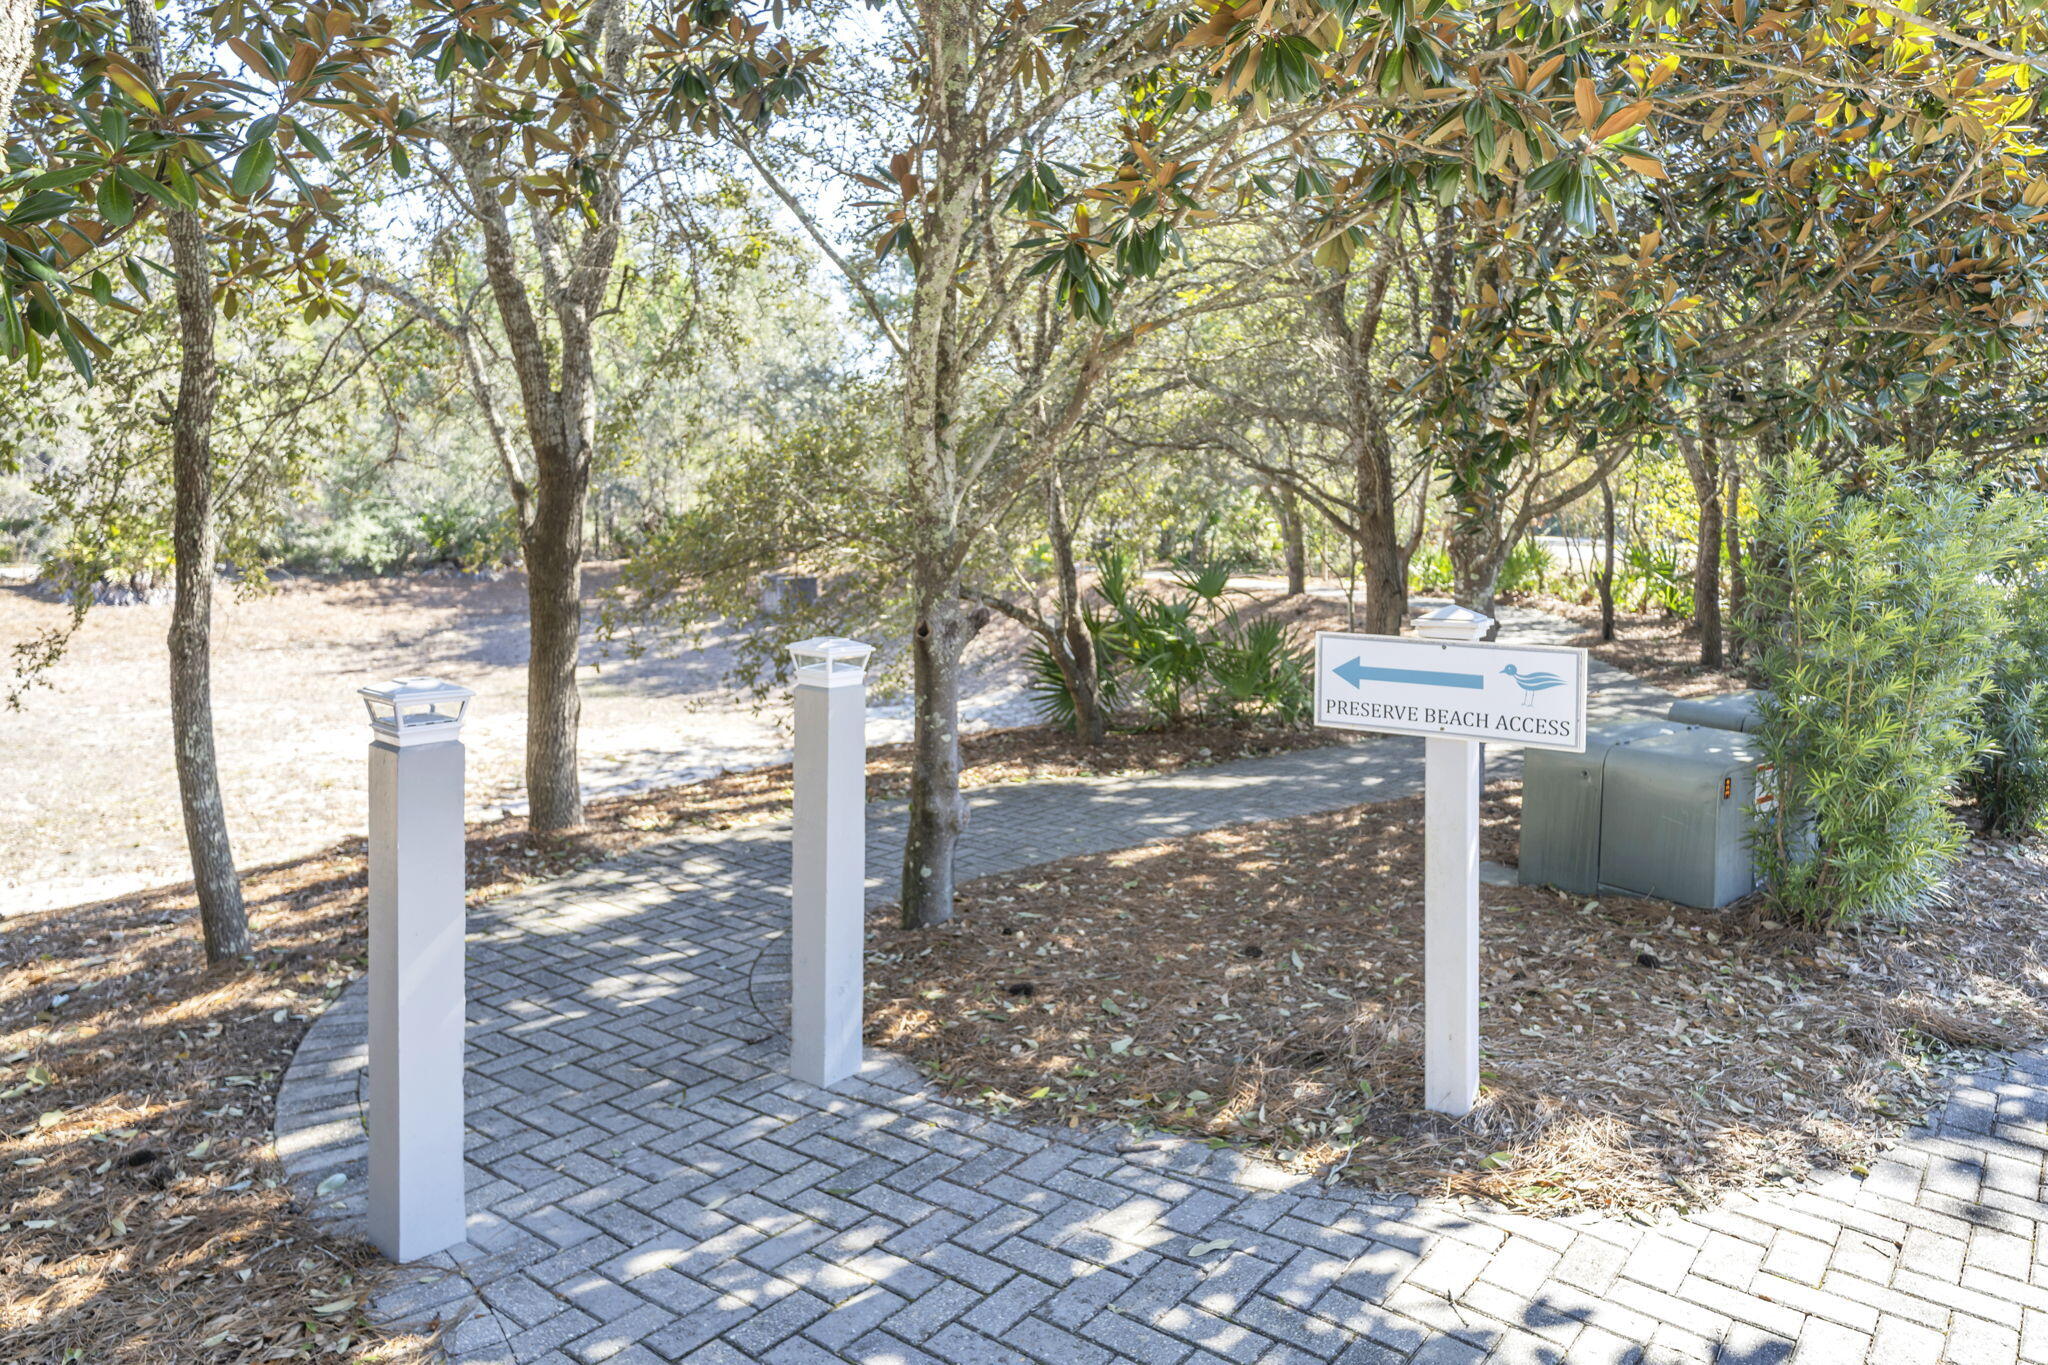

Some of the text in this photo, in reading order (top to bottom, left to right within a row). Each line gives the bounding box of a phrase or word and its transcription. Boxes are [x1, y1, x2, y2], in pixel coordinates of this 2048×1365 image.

[1326, 699, 1570, 737] PRESERVE BEACH ACCESS
